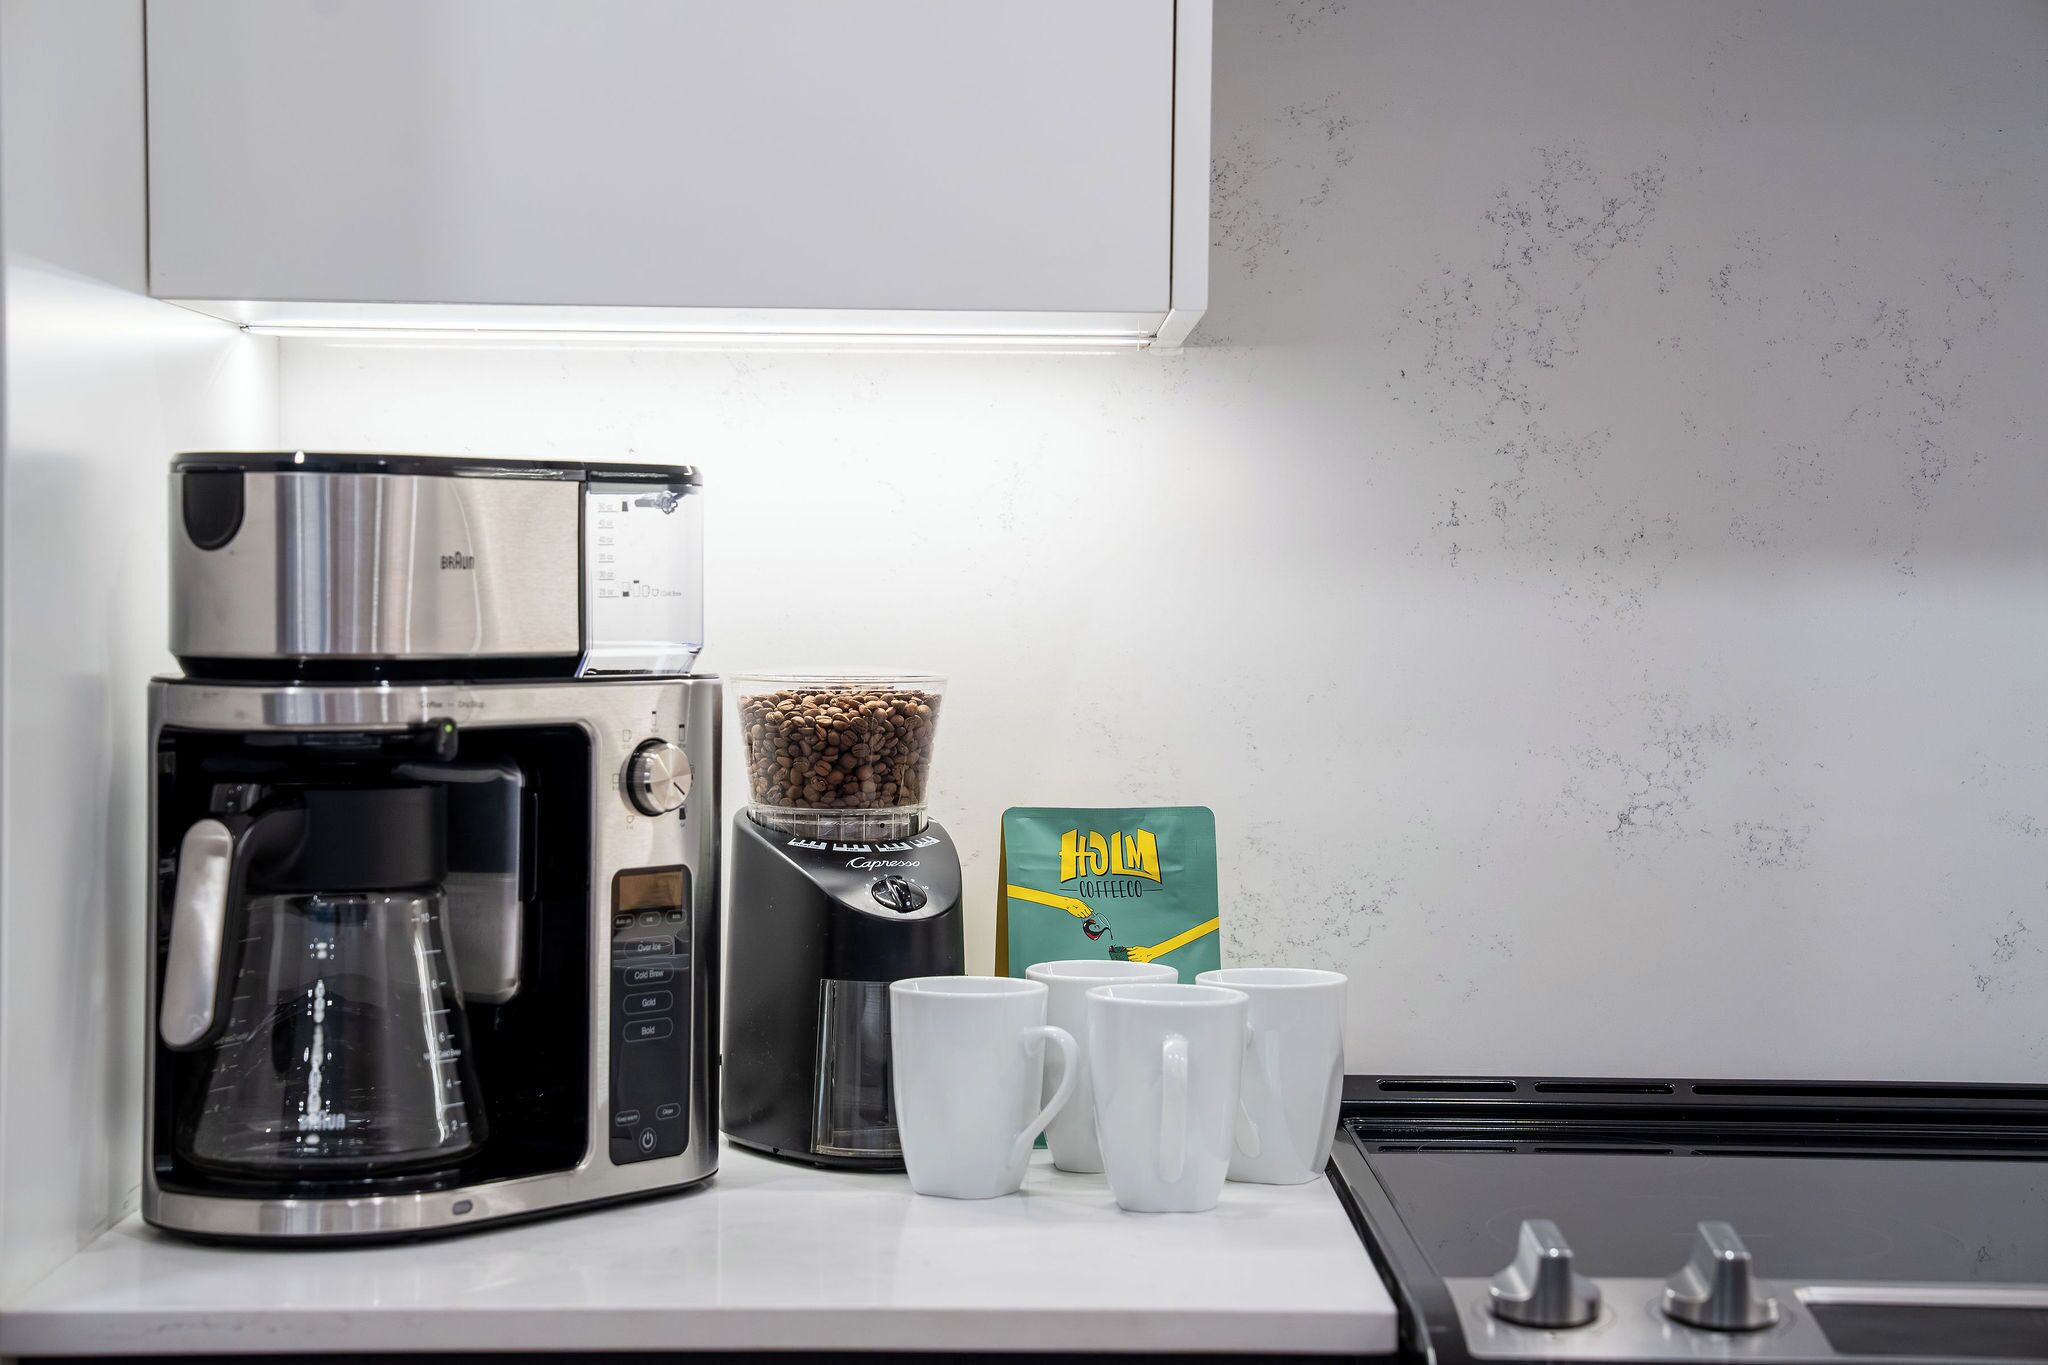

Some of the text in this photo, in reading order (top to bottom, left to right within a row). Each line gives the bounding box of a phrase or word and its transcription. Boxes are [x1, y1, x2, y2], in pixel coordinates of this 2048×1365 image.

[441, 551, 475, 570] BRAUN
[1059, 828, 1163, 884] HOLM
[845, 857, 921, 871] Capresso
[637, 943, 652, 952] Over
[634, 968, 664, 980] Cold Brew
[641, 998, 656, 1007] Gold
[641, 1025, 656, 1036] Bold
